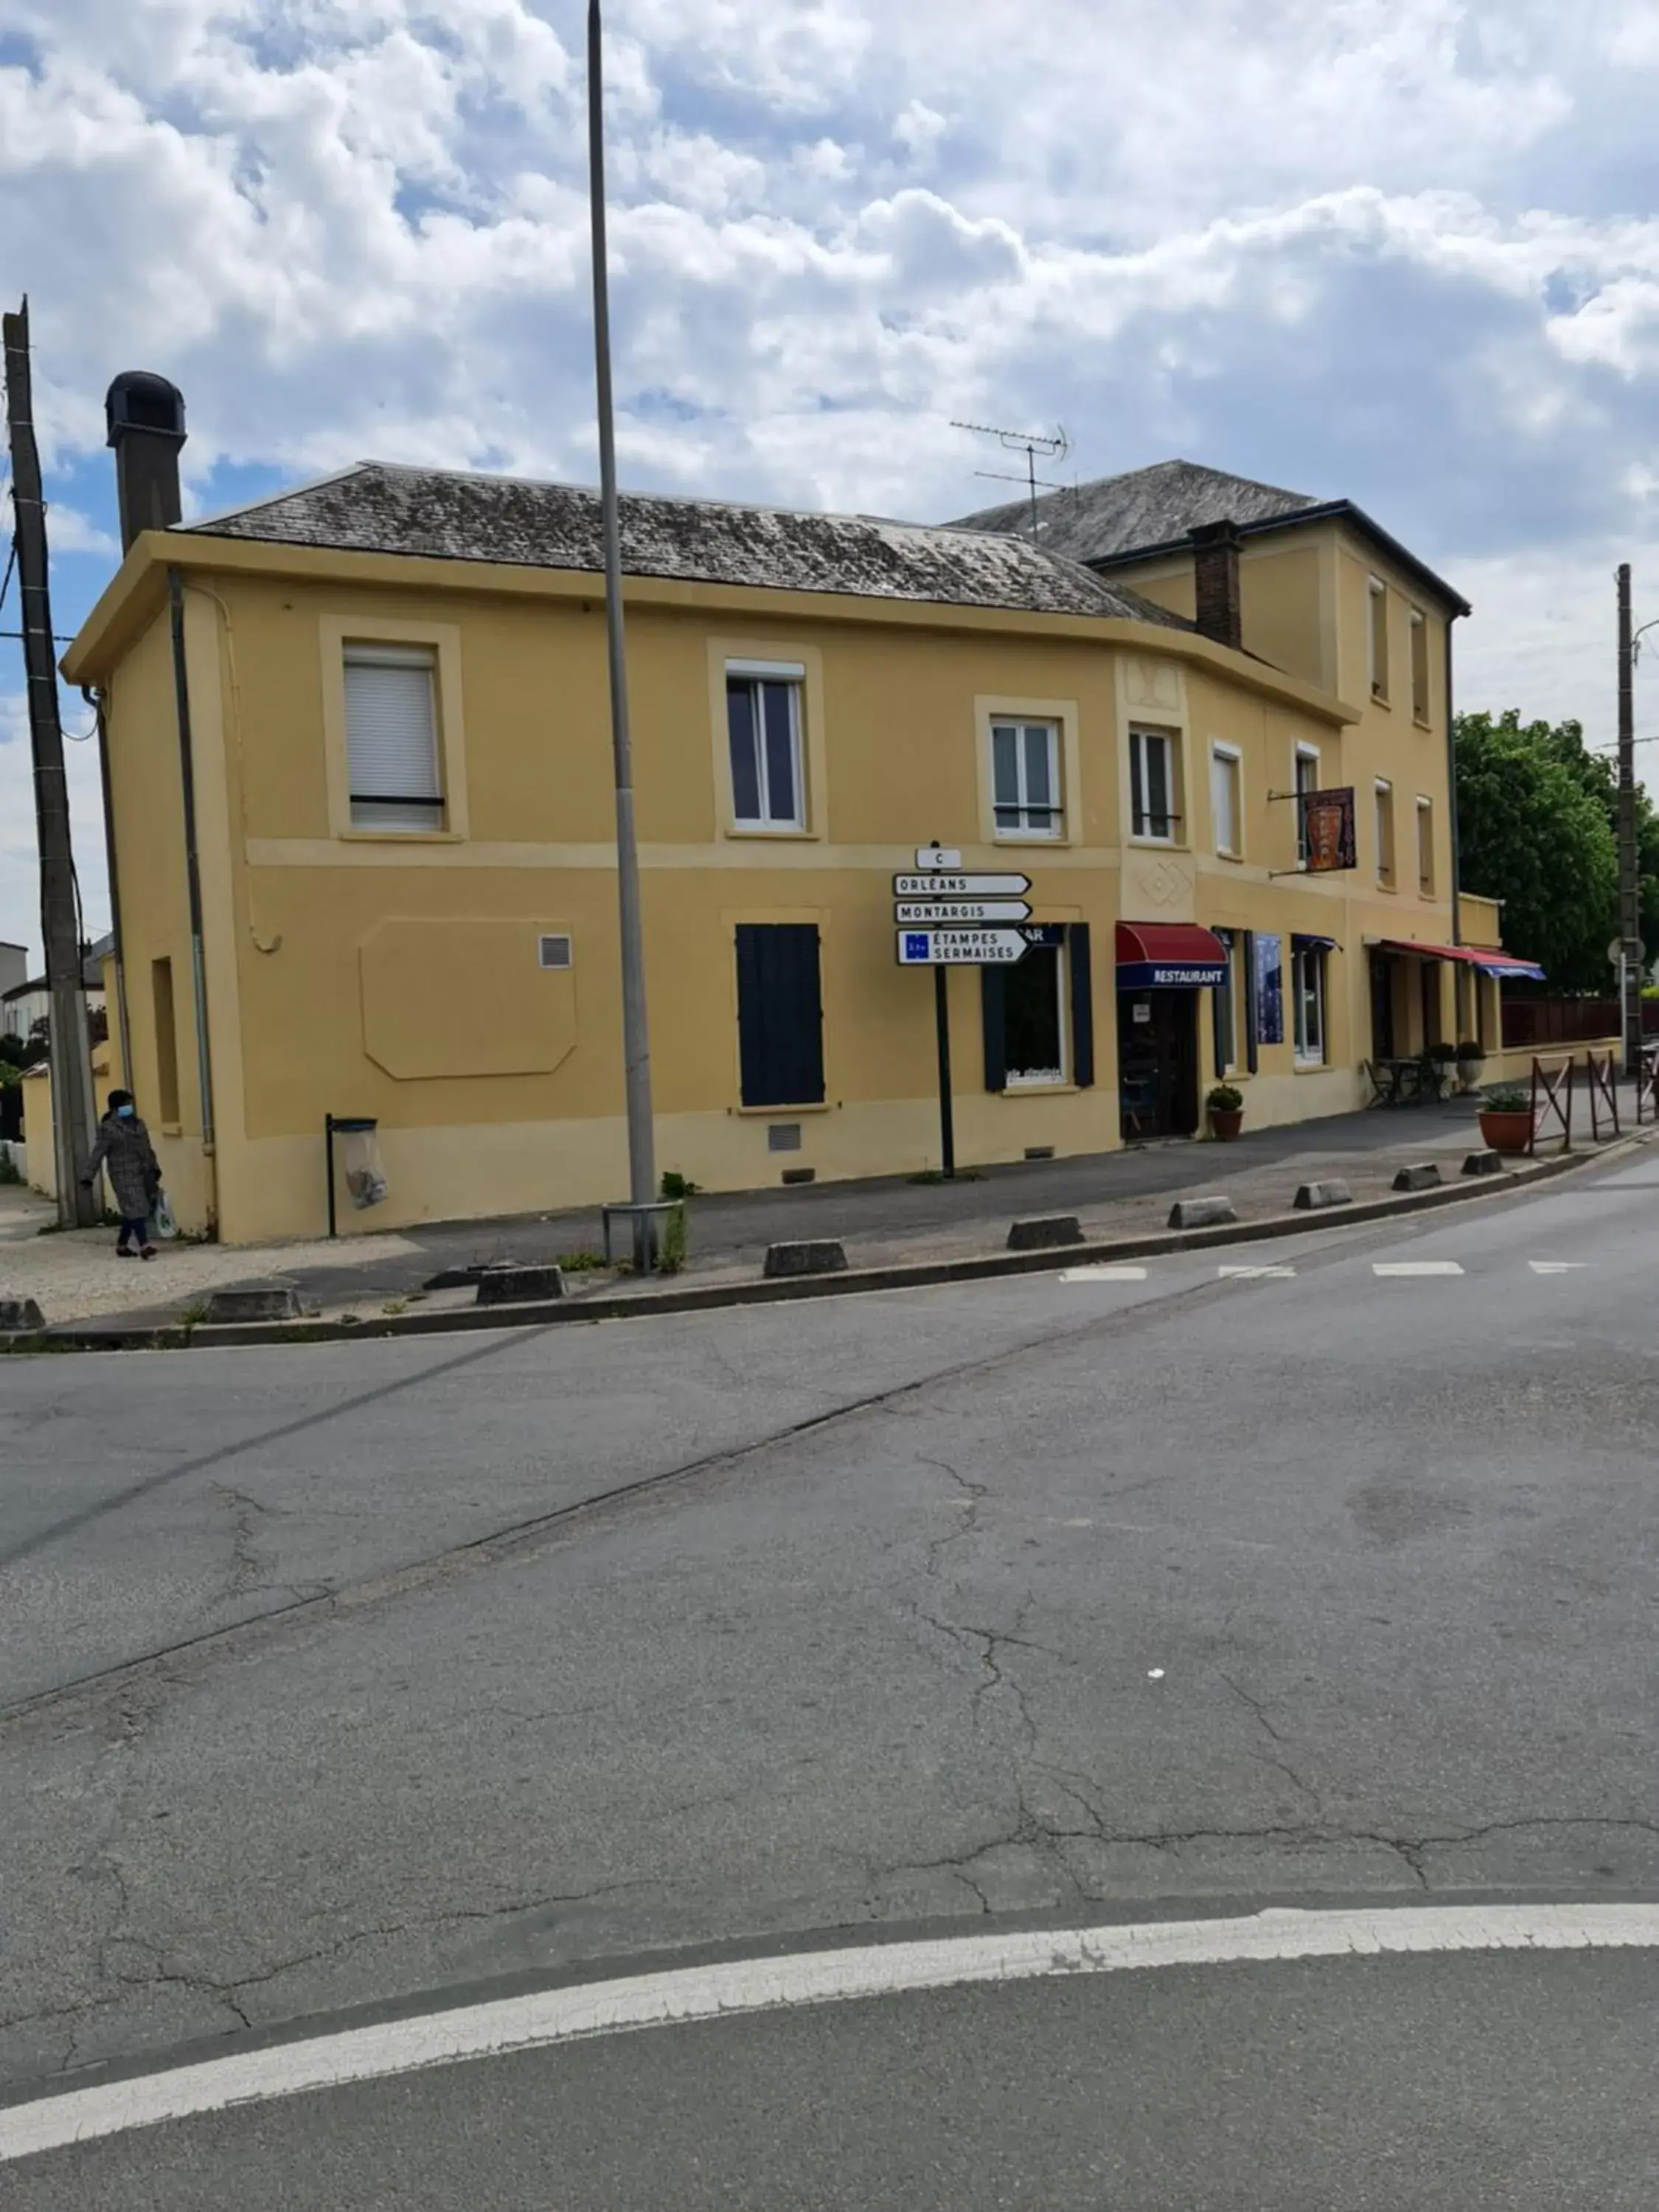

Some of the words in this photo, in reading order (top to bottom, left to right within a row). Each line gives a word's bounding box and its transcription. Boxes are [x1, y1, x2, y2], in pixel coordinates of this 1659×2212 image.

[936, 853, 943, 864] C
[900, 878, 967, 891] ORLÉANS
[901, 906, 984, 919] MONTARGIS
[933, 933, 998, 945] ÉTAMPES
[934, 947, 1013, 959] SERMAISES
[1154, 970, 1222, 983] RESTAURANT
